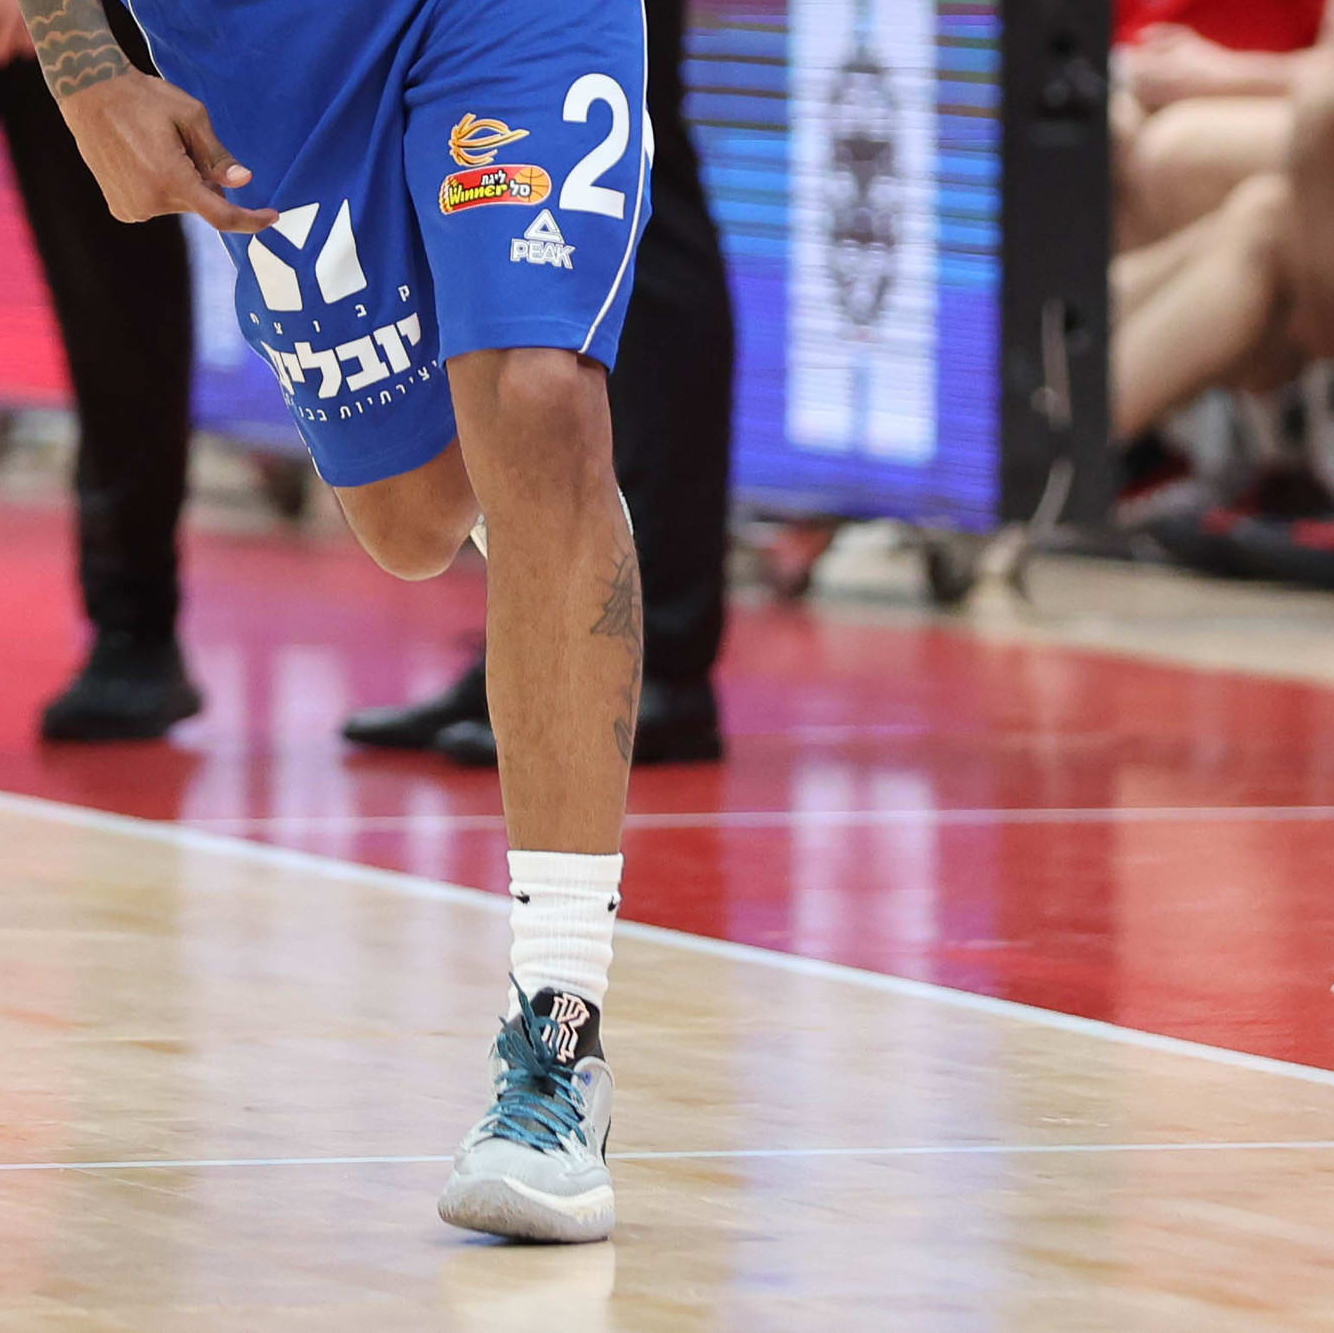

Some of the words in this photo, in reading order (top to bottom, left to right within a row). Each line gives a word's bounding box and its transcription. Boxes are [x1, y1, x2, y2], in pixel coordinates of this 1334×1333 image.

[559, 73, 631, 220] 2
[449, 183, 508, 206] Winner
[510, 180, 531, 196] סל
[510, 238, 576, 270] PEAK
